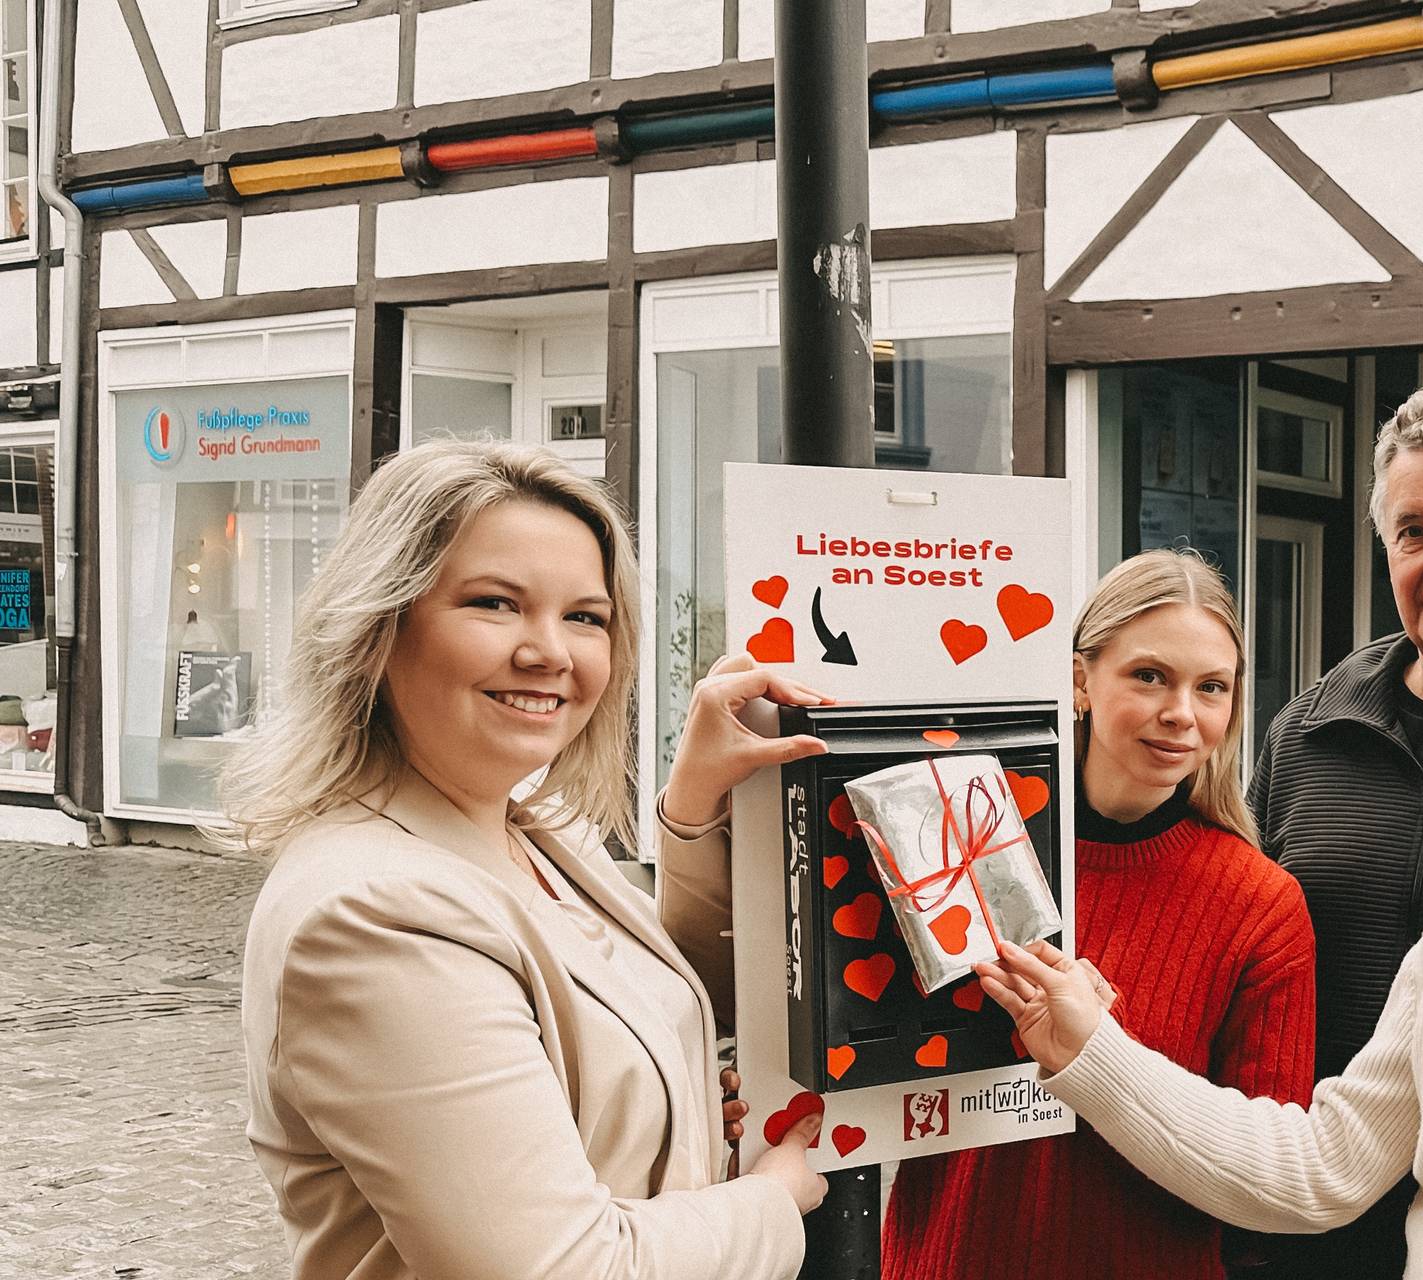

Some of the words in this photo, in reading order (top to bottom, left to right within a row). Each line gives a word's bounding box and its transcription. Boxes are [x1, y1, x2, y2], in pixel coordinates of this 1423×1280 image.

[241, 432, 321, 455] Grundmann
[796, 532, 1014, 562] Liebesbriefe
[831, 567, 874, 585] an
[883, 565, 984, 588] Soest
[176, 652, 193, 721] FUSSKRAFT
[797, 785, 809, 876] stadt
[787, 783, 803, 1001] LABOR
[961, 1079, 1057, 1113] mitwirke
[1017, 1112, 1028, 1124] in
[1032, 1105, 1063, 1122] Soest
